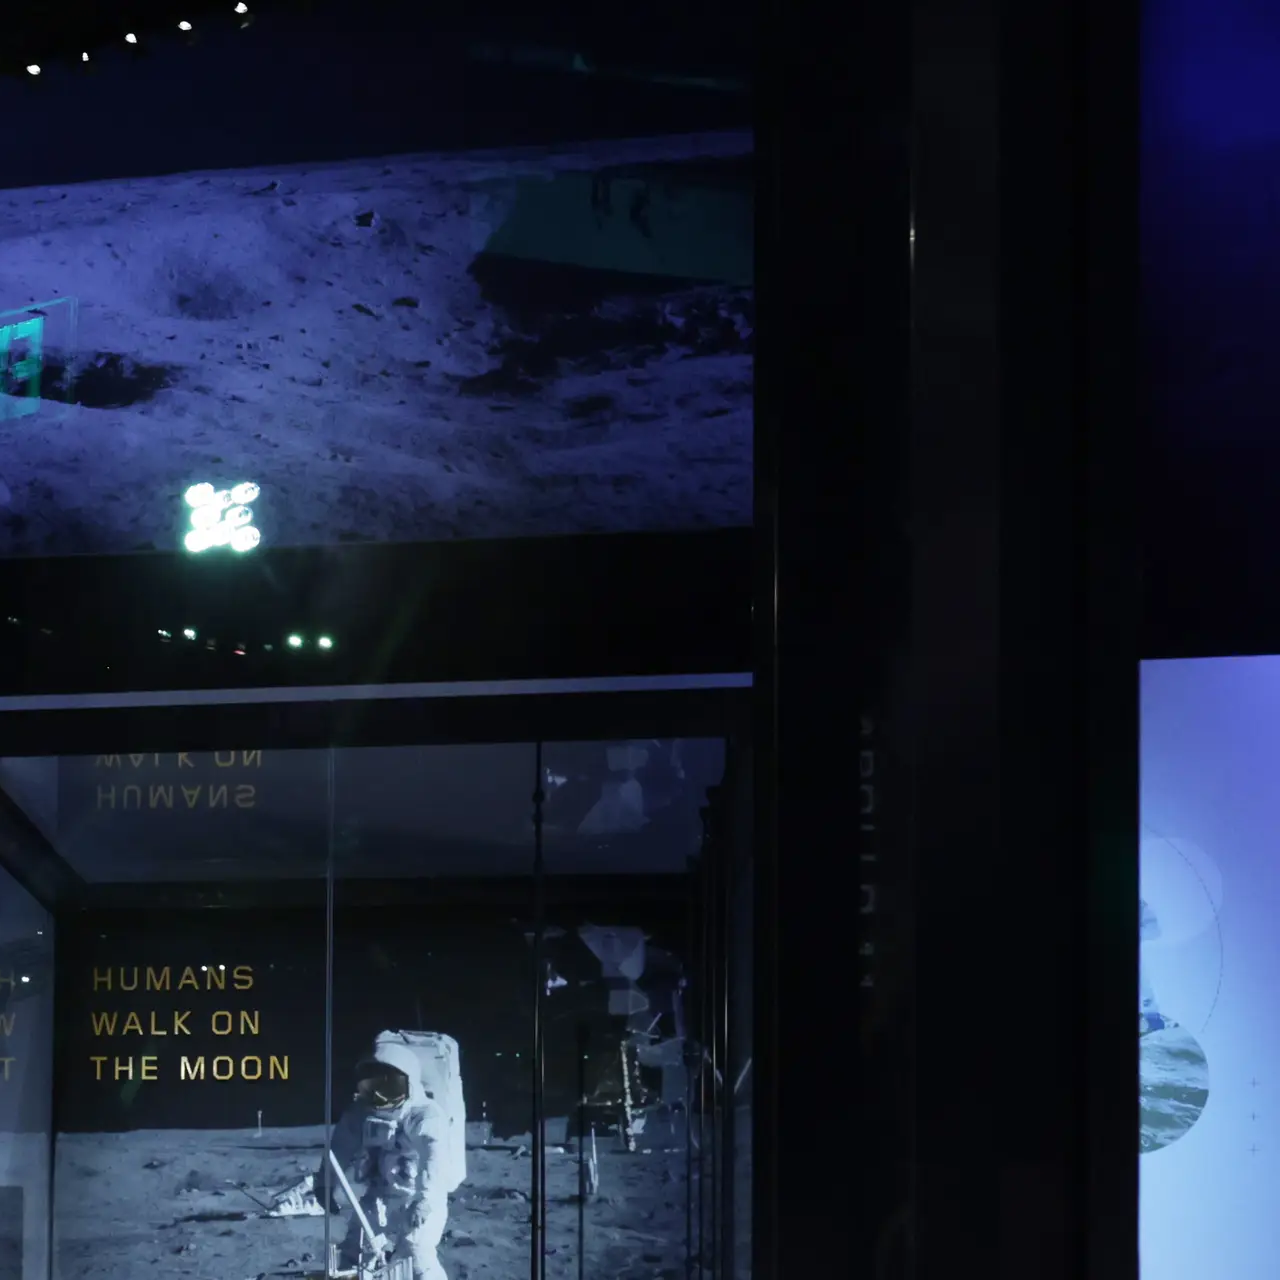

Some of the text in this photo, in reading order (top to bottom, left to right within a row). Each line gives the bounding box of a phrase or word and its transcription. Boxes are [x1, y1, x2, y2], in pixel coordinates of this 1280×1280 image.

[92, 965, 255, 991] HUMANS
[91, 1010, 261, 1036] WALK ON
[89, 1055, 290, 1081] THE MOON
